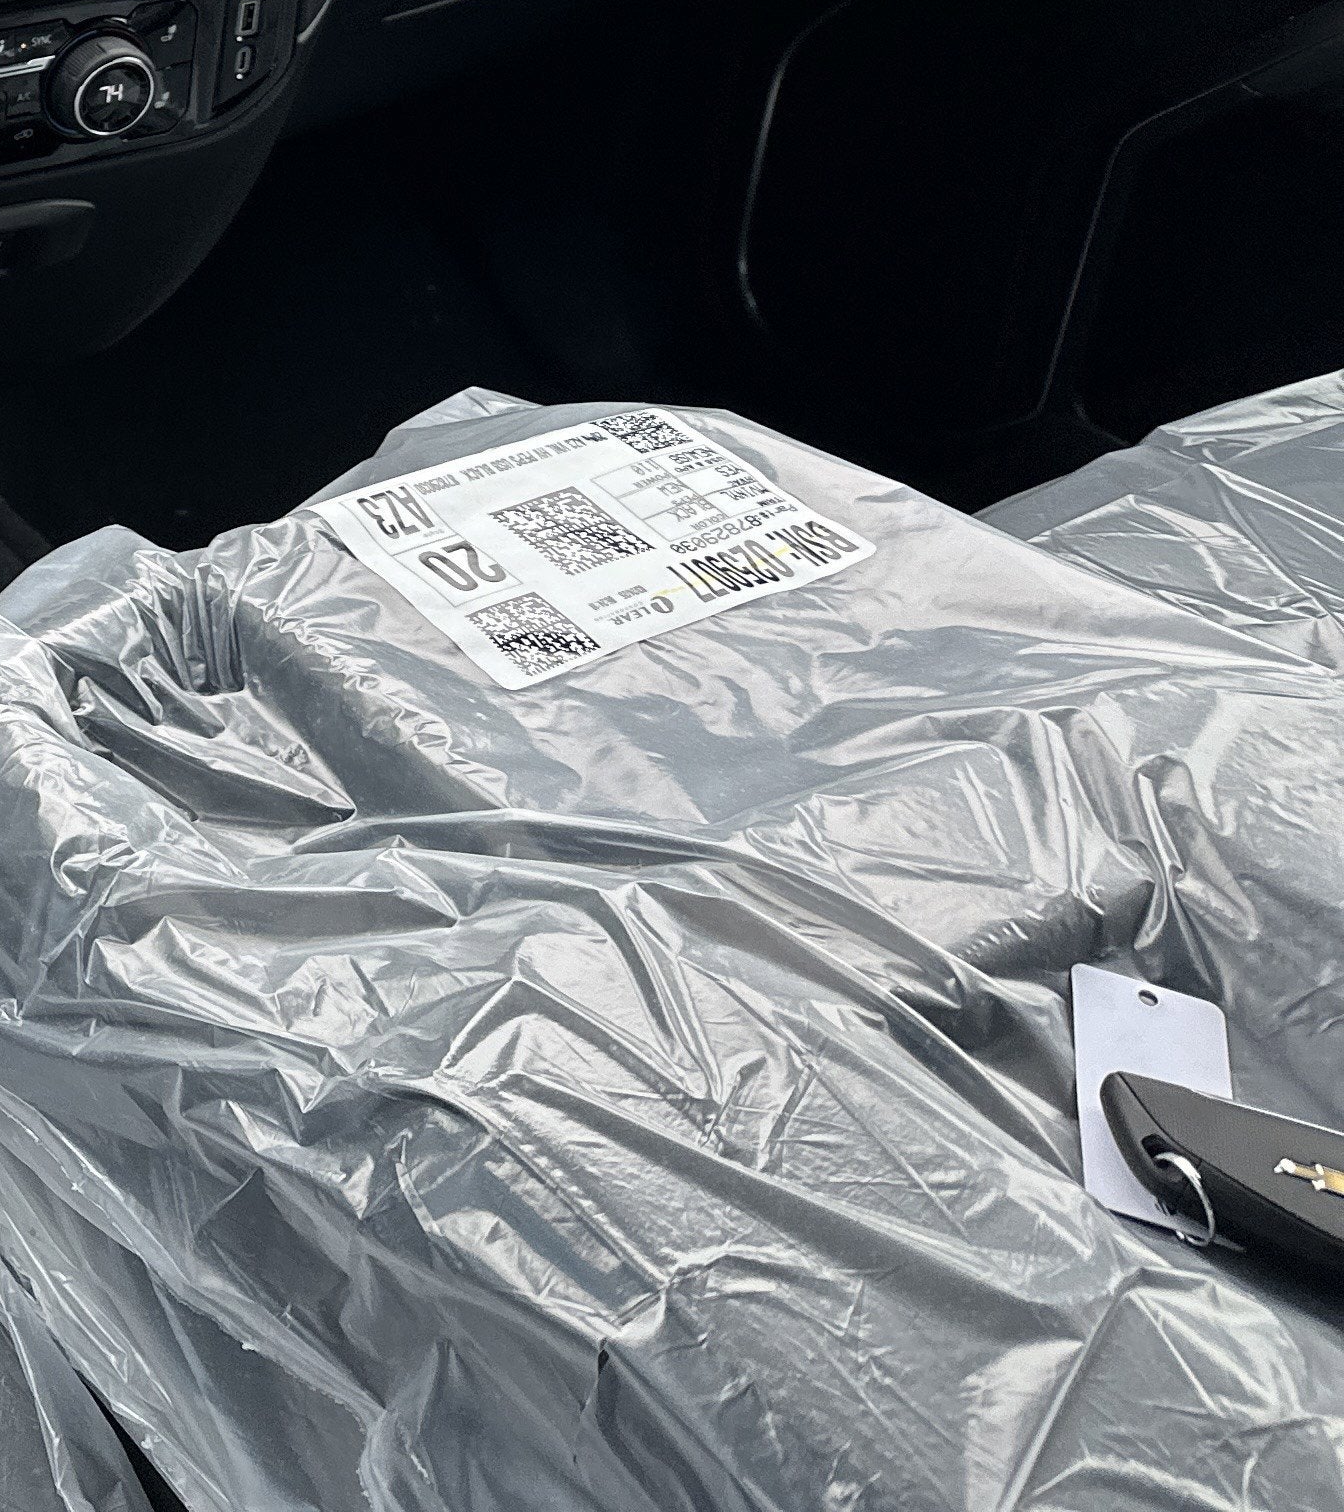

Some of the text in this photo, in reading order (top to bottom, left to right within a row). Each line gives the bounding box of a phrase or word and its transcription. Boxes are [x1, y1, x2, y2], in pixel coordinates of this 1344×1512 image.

[99, 83, 124, 103] 74
[714, 464, 745, 477] YES
[357, 486, 433, 538] AZ3
[419, 540, 505, 591] 20
[667, 521, 859, 603] BSN: 0259077
[609, 606, 651, 625] LEAR
